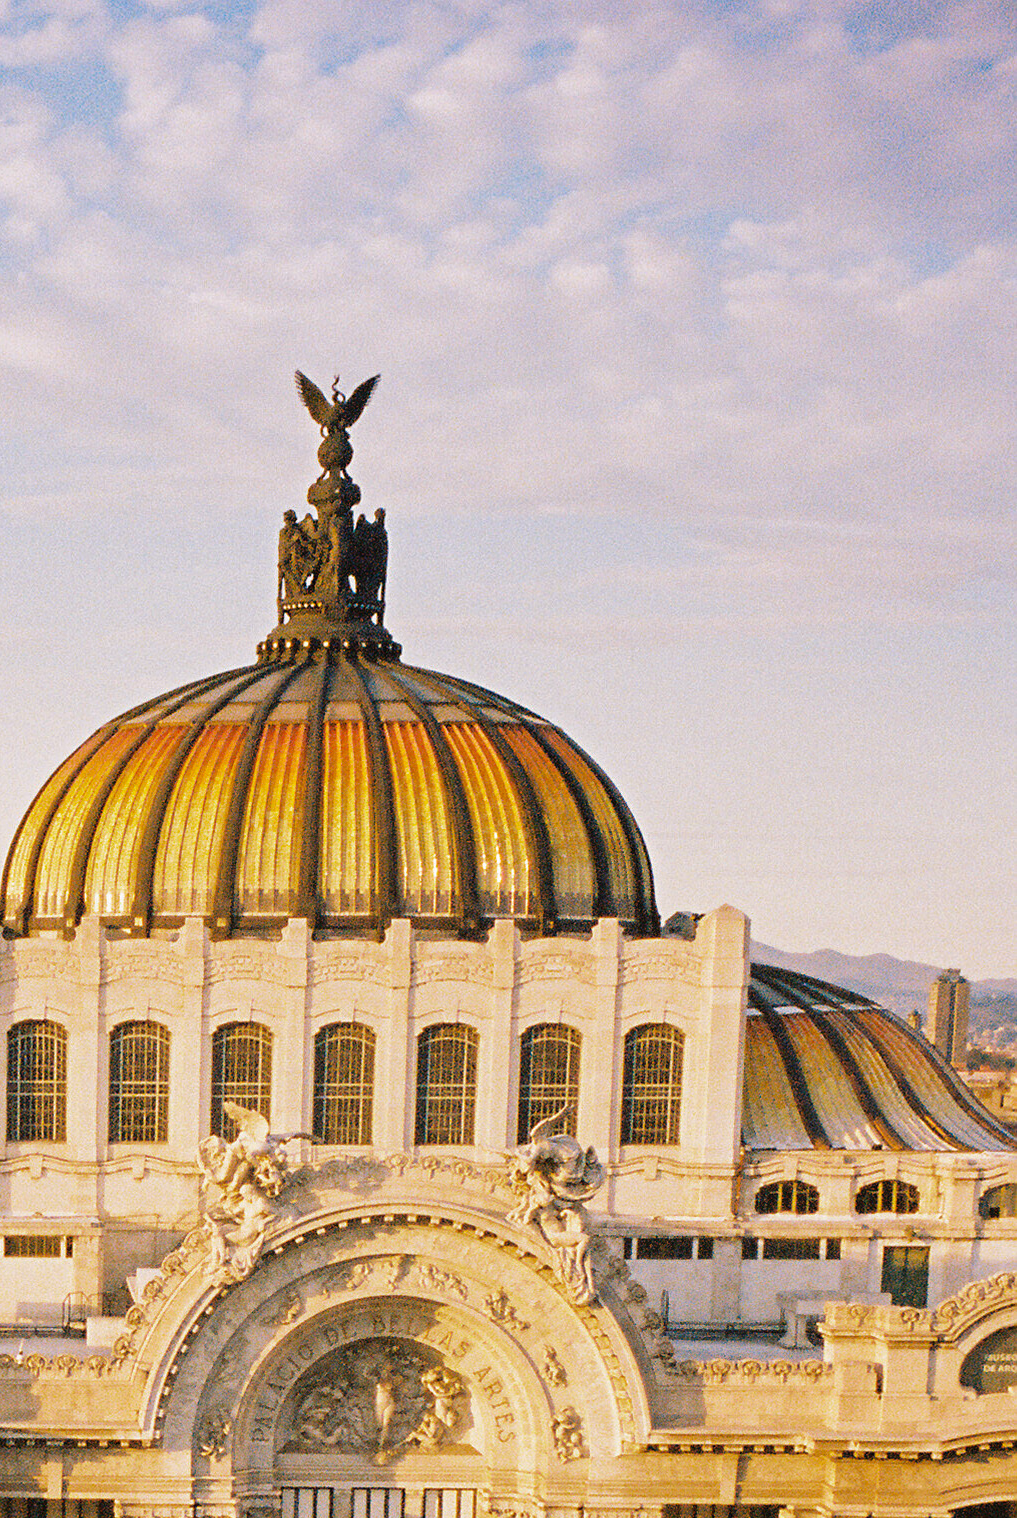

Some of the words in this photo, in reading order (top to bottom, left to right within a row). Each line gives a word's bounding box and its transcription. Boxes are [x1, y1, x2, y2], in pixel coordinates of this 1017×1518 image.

[251, 1343, 314, 1442] PALACIO
[323, 1320, 358, 1346] DE
[372, 1315, 471, 1358] BELLAS
[472, 1365, 516, 1443] ARTES
